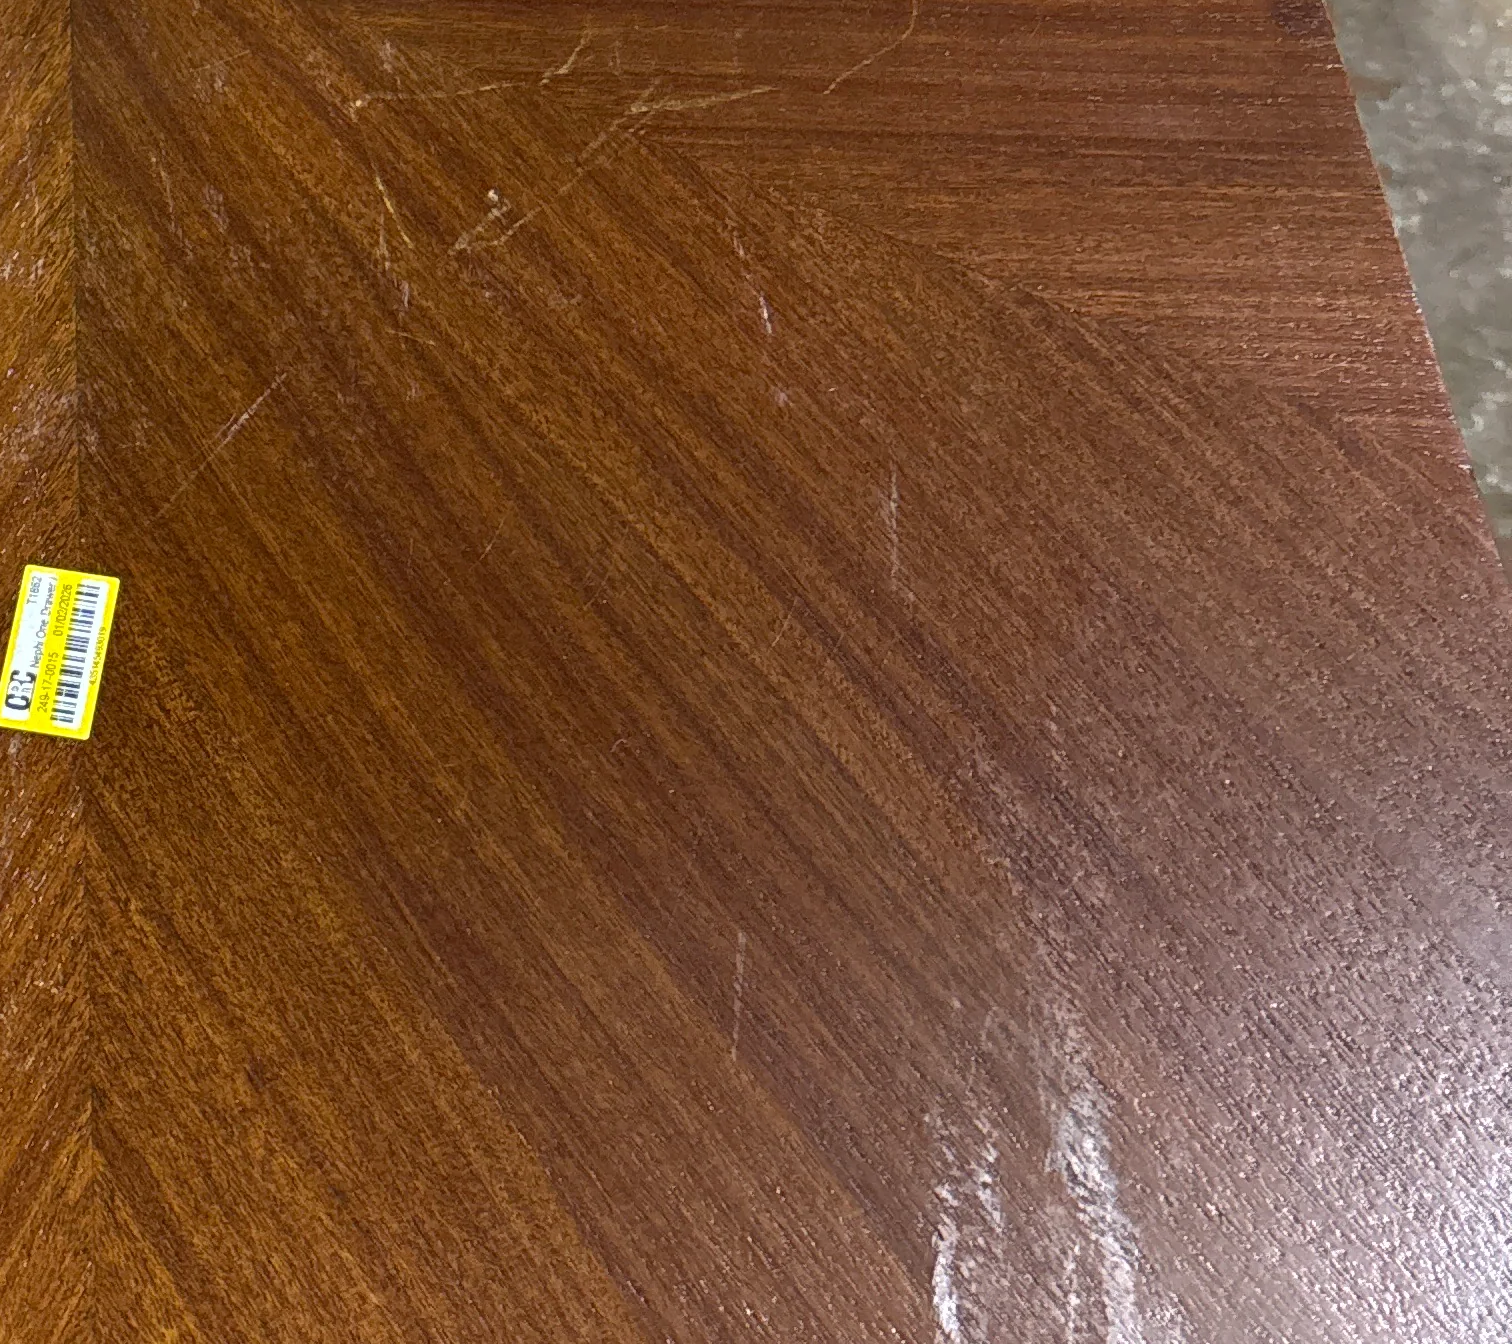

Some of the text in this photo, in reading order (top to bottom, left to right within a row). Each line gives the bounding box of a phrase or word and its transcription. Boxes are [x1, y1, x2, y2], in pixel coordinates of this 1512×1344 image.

[40, 582, 56, 617] Drawer
[36, 618, 50, 640] One
[30, 641, 45, 669] Nephi
[37, 651, 59, 714] 249-17-0015
